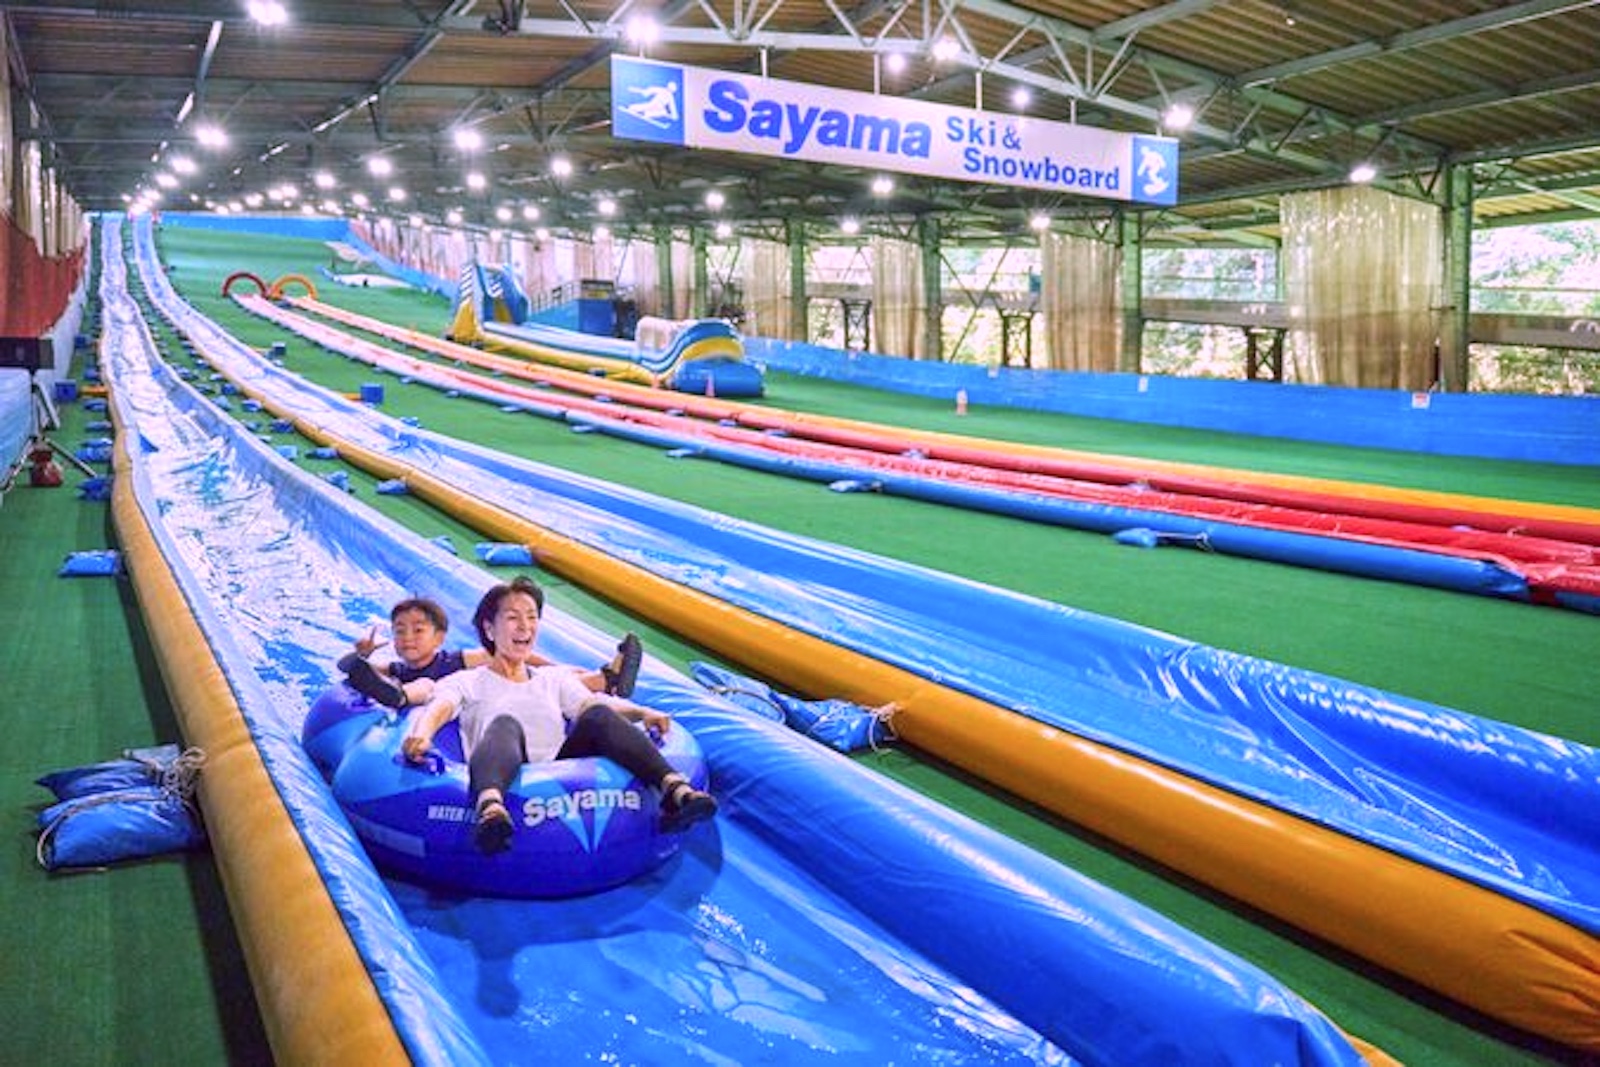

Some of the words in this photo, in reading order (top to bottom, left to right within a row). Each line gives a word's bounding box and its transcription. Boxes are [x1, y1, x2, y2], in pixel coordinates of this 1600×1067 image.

[704, 80, 932, 158] Sayama
[964, 148, 1120, 190] Snowboard
[523, 789, 641, 827] Sayama
